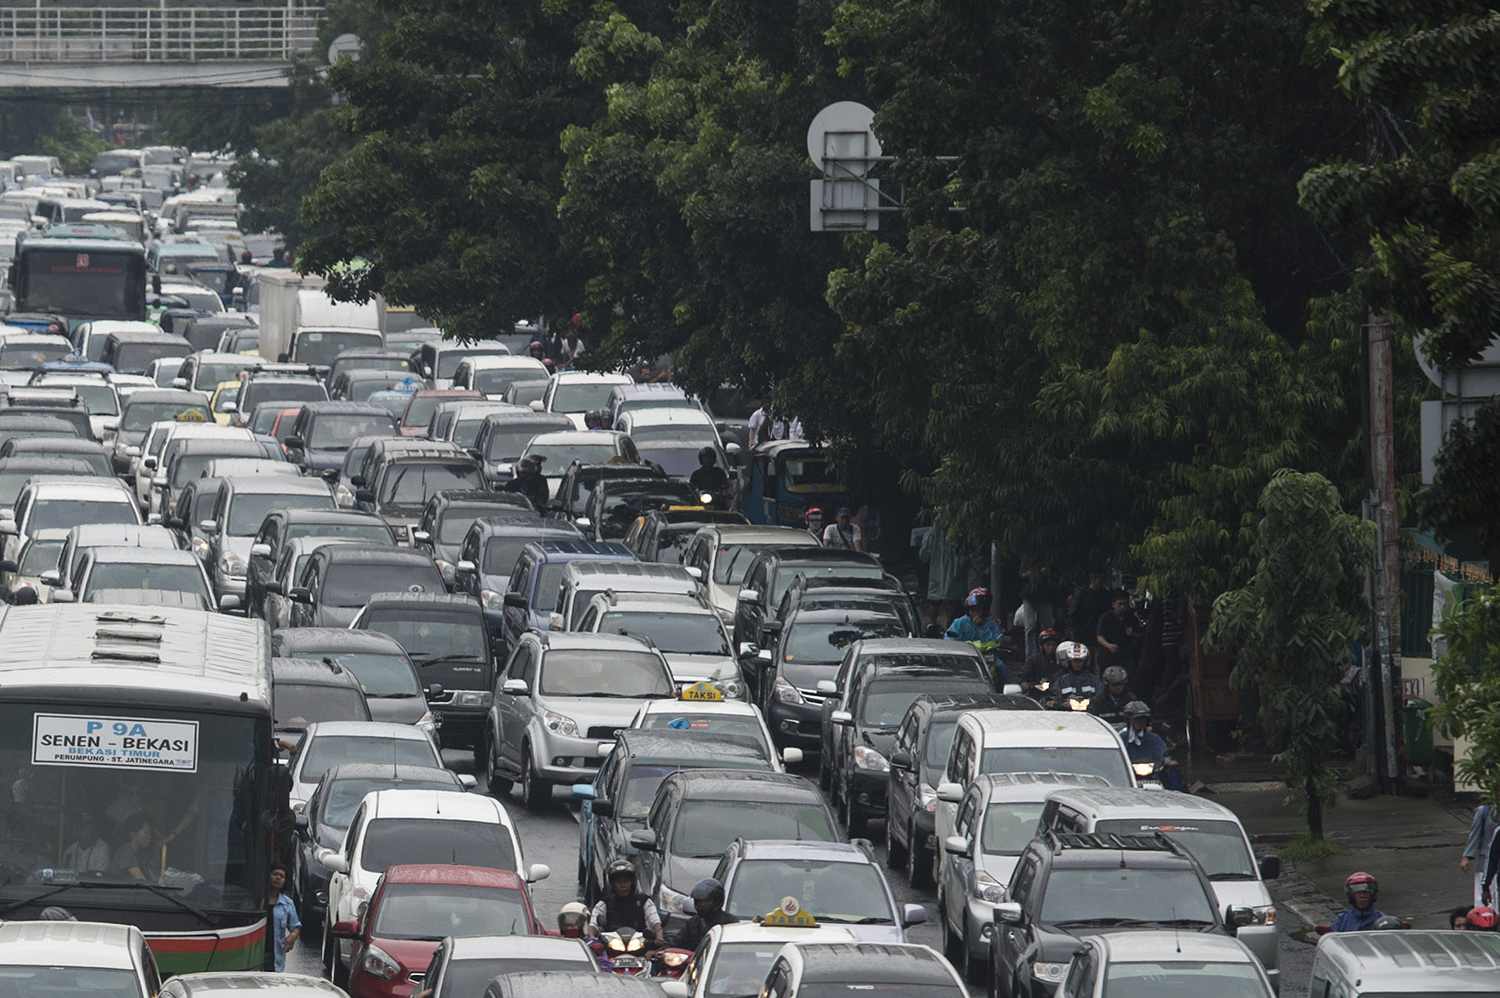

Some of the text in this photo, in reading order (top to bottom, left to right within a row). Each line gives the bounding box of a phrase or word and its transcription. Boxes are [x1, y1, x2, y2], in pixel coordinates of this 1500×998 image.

[689, 691, 716, 699] TAKSI
[87, 721, 147, 737] P 9A
[40, 735, 100, 748] SENEN
[123, 737, 189, 752] BEKASI
[68, 747, 161, 758] BEKASI TIMUR
[125, 758, 175, 766] JATINEGARA
[771, 915, 810, 925] TAKSI
